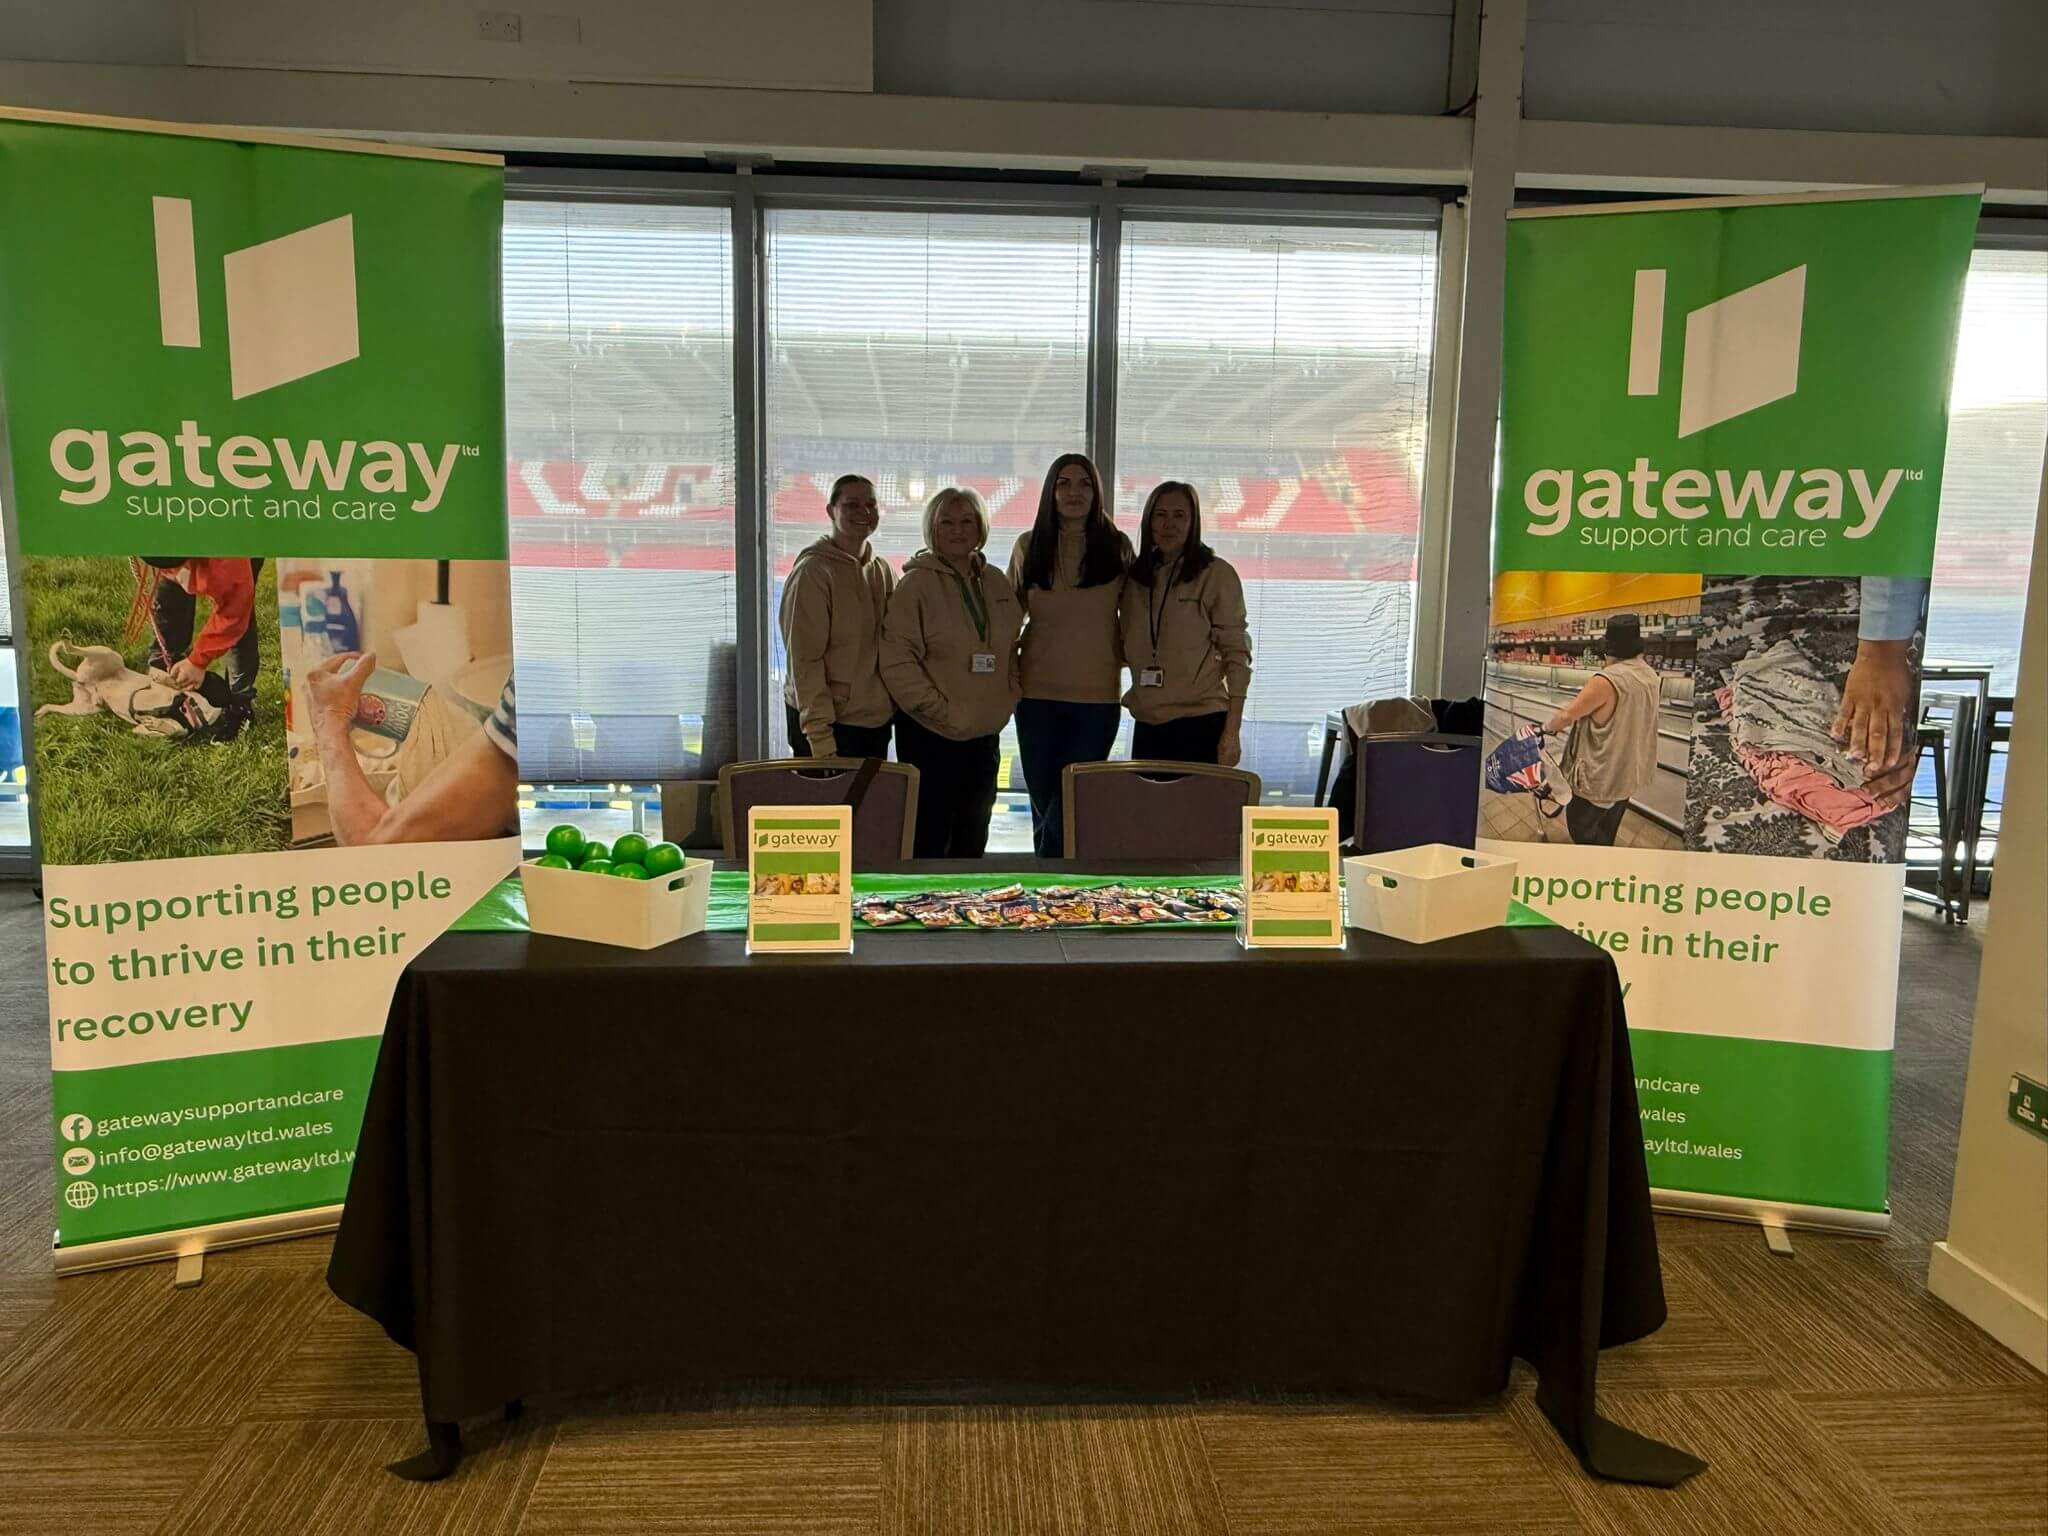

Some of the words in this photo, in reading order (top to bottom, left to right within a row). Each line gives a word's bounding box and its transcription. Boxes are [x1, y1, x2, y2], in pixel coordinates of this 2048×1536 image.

[50, 420, 460, 512] gateway
[462, 445, 480, 457] ltd
[127, 494, 253, 521] support
[264, 494, 321, 519] and
[332, 500, 396, 520] care
[1524, 458, 1904, 538] gateway
[1906, 469, 1923, 481] ltd
[1580, 524, 1688, 550] support
[1697, 523, 1750, 547] and
[1762, 527, 1826, 547] care
[771, 832, 837, 848] gateway
[1267, 832, 1326, 847] gateway
[50, 883, 300, 934] Supporting
[311, 871, 451, 916] people
[1695, 886, 1831, 920] people
[51, 956, 95, 985] to
[108, 944, 244, 982] thrive
[257, 937, 295, 967] in
[307, 926, 406, 963] their
[1642, 926, 1673, 955] in
[1686, 929, 1778, 963] their
[56, 999, 253, 1042] recovery
[97, 1087, 344, 1136] gatewaysupportandcare
[100, 1120, 333, 1166] info@gatewayltd.wales
